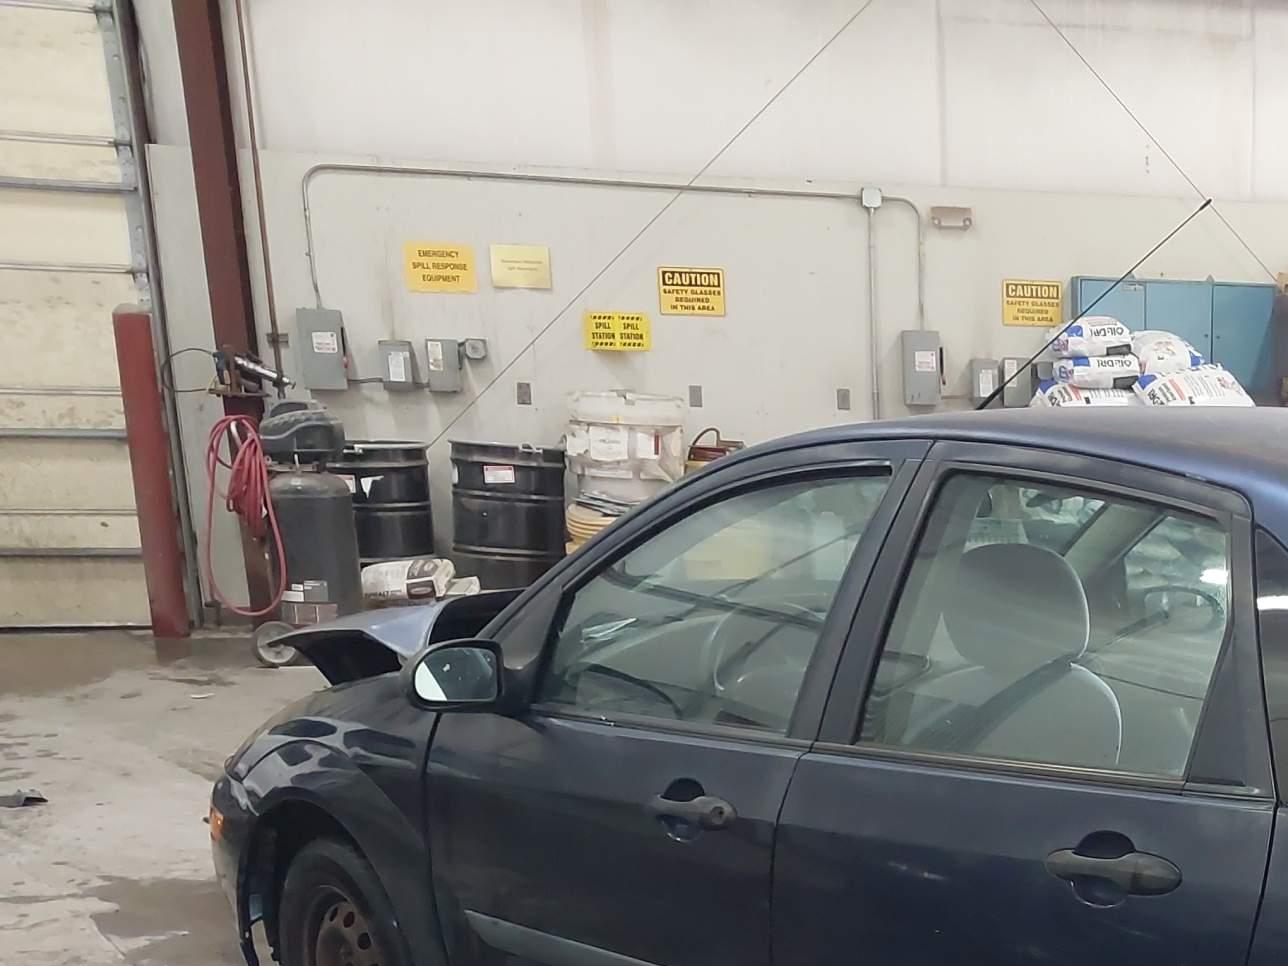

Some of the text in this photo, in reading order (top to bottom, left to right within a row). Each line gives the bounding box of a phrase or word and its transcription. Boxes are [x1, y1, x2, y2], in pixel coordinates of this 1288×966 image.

[418, 249, 459, 258] EMERGENCY
[412, 261, 468, 271] SPILL RESPONSE
[422, 274, 460, 283] EQUIPMENT
[664, 272, 719, 286] CAUTION
[690, 288, 721, 296] GLASSES
[1008, 284, 1058, 298] CAUTION
